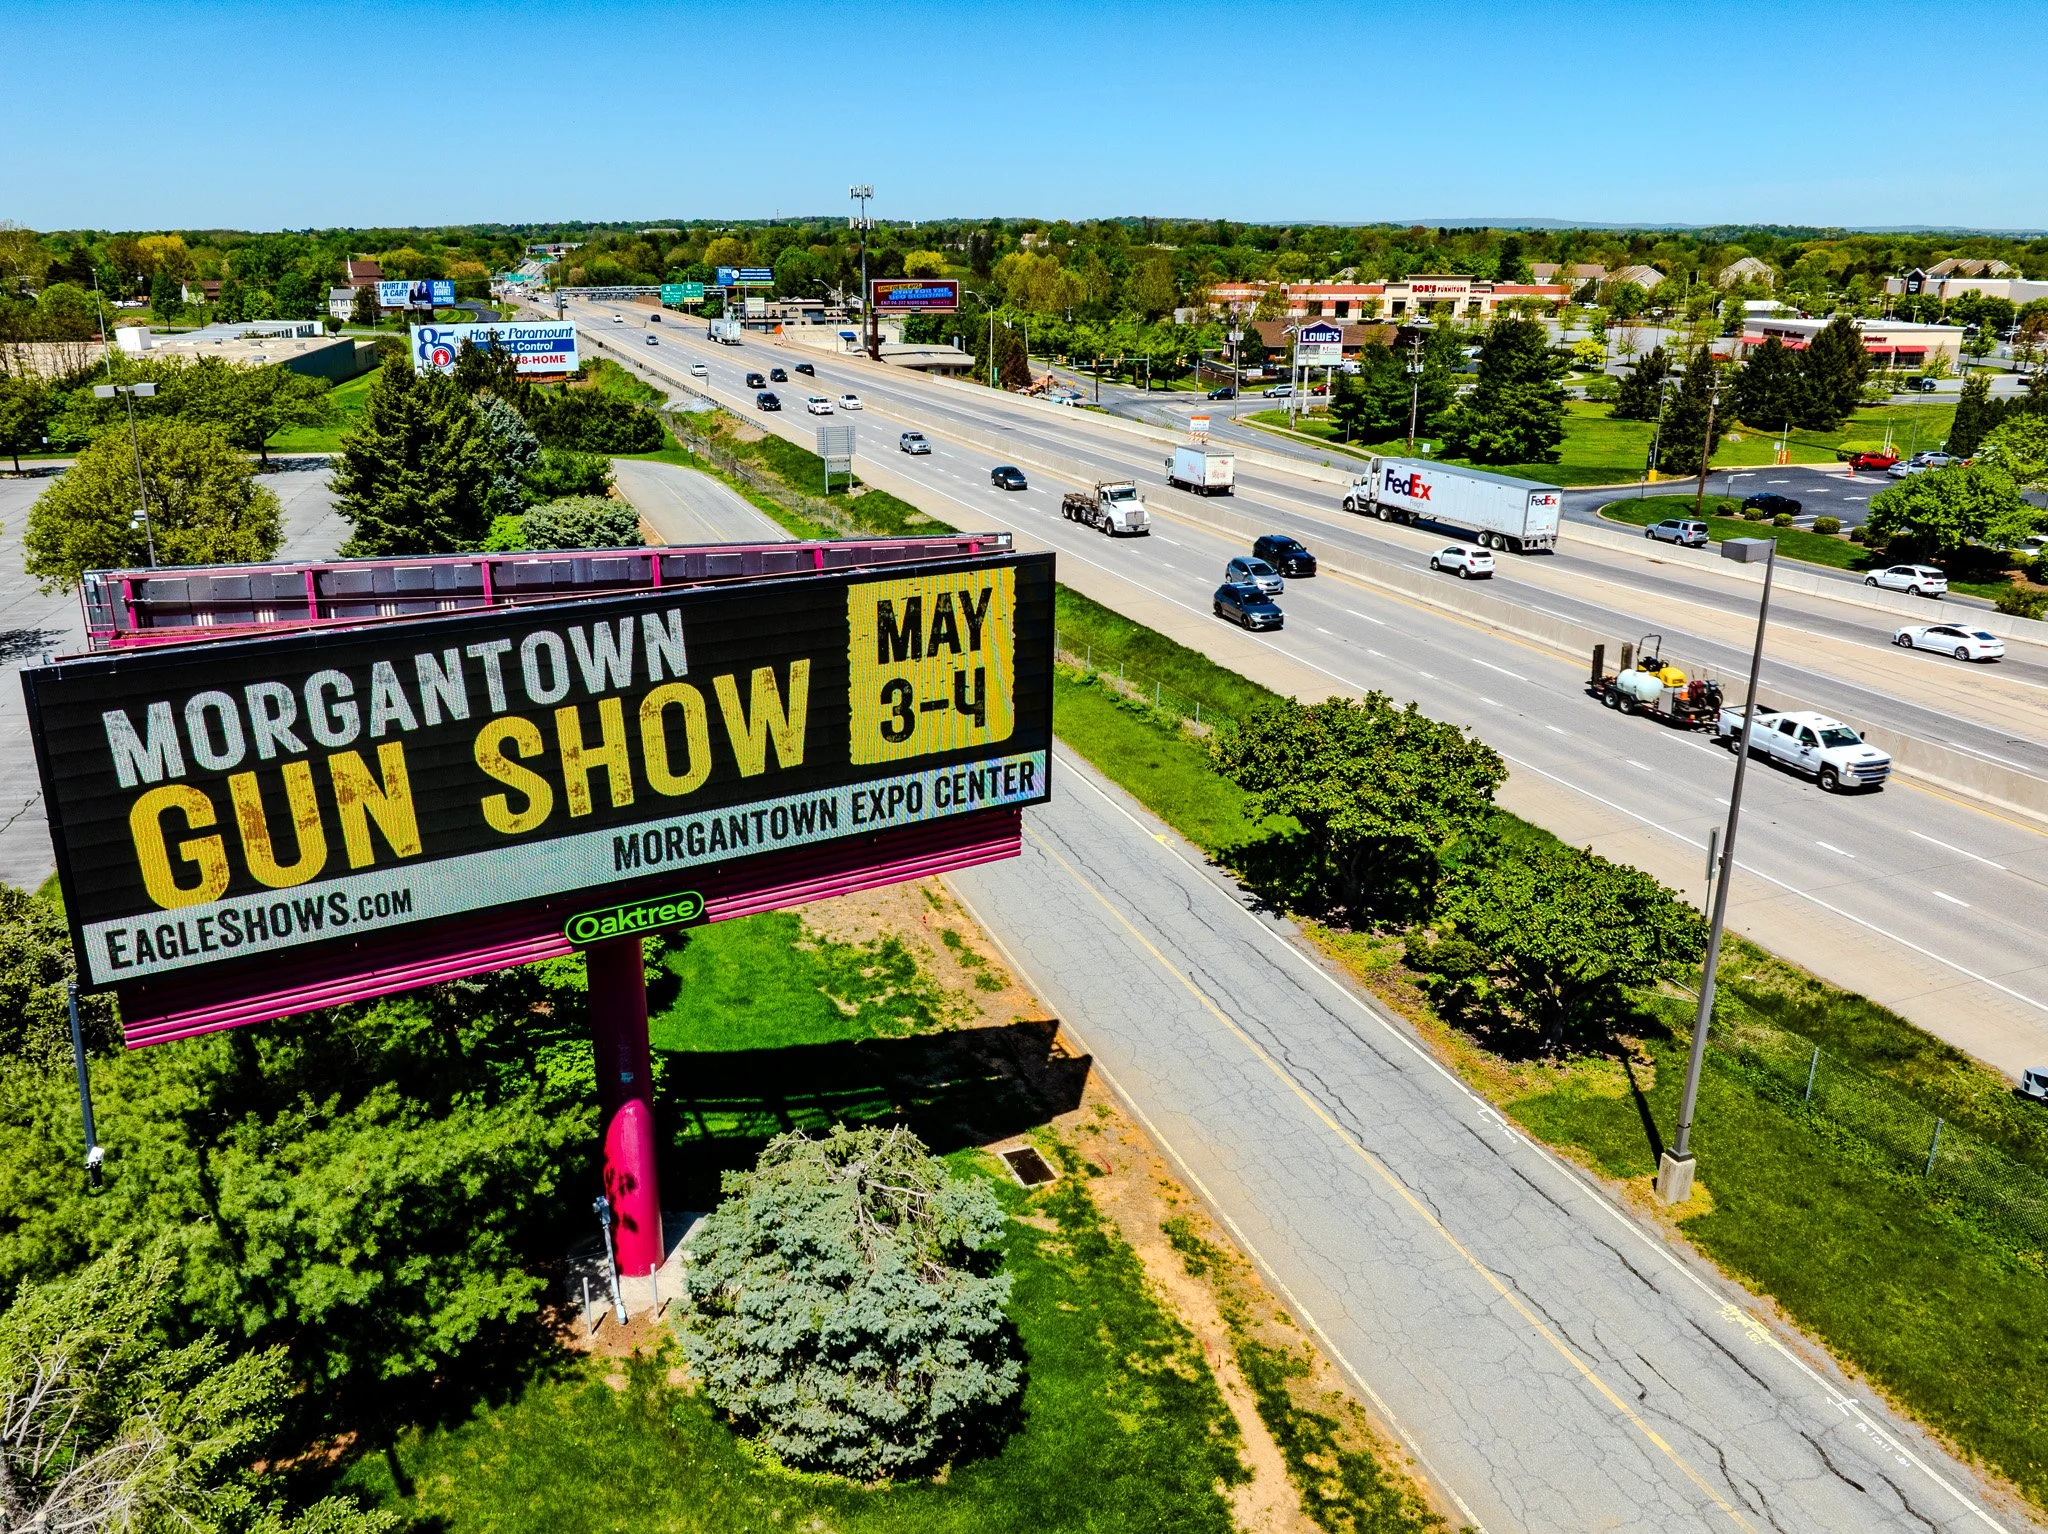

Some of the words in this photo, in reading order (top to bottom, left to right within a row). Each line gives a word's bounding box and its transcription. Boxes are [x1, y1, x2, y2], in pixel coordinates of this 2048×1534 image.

[908, 291, 954, 299] SIGHTINGS
[1412, 285, 1437, 293] BOB'S
[508, 327, 574, 339] Paramount
[518, 341, 553, 351] Control
[1302, 331, 1340, 342] LOWE'S
[1385, 468, 1432, 501] FedEx
[1531, 495, 1557, 506] FedEx
[877, 587, 993, 666] MAY
[102, 608, 689, 789] MORGANTOWN
[129, 741, 423, 911] GUN
[473, 658, 811, 834] SHOW
[613, 795, 839, 872] MORGANTOWN
[851, 781, 923, 825] EXPO
[934, 760, 1035, 808] CENTER
[105, 888, 413, 970] EAGLESHOWS.COM
[576, 900, 694, 938] Oaktree
